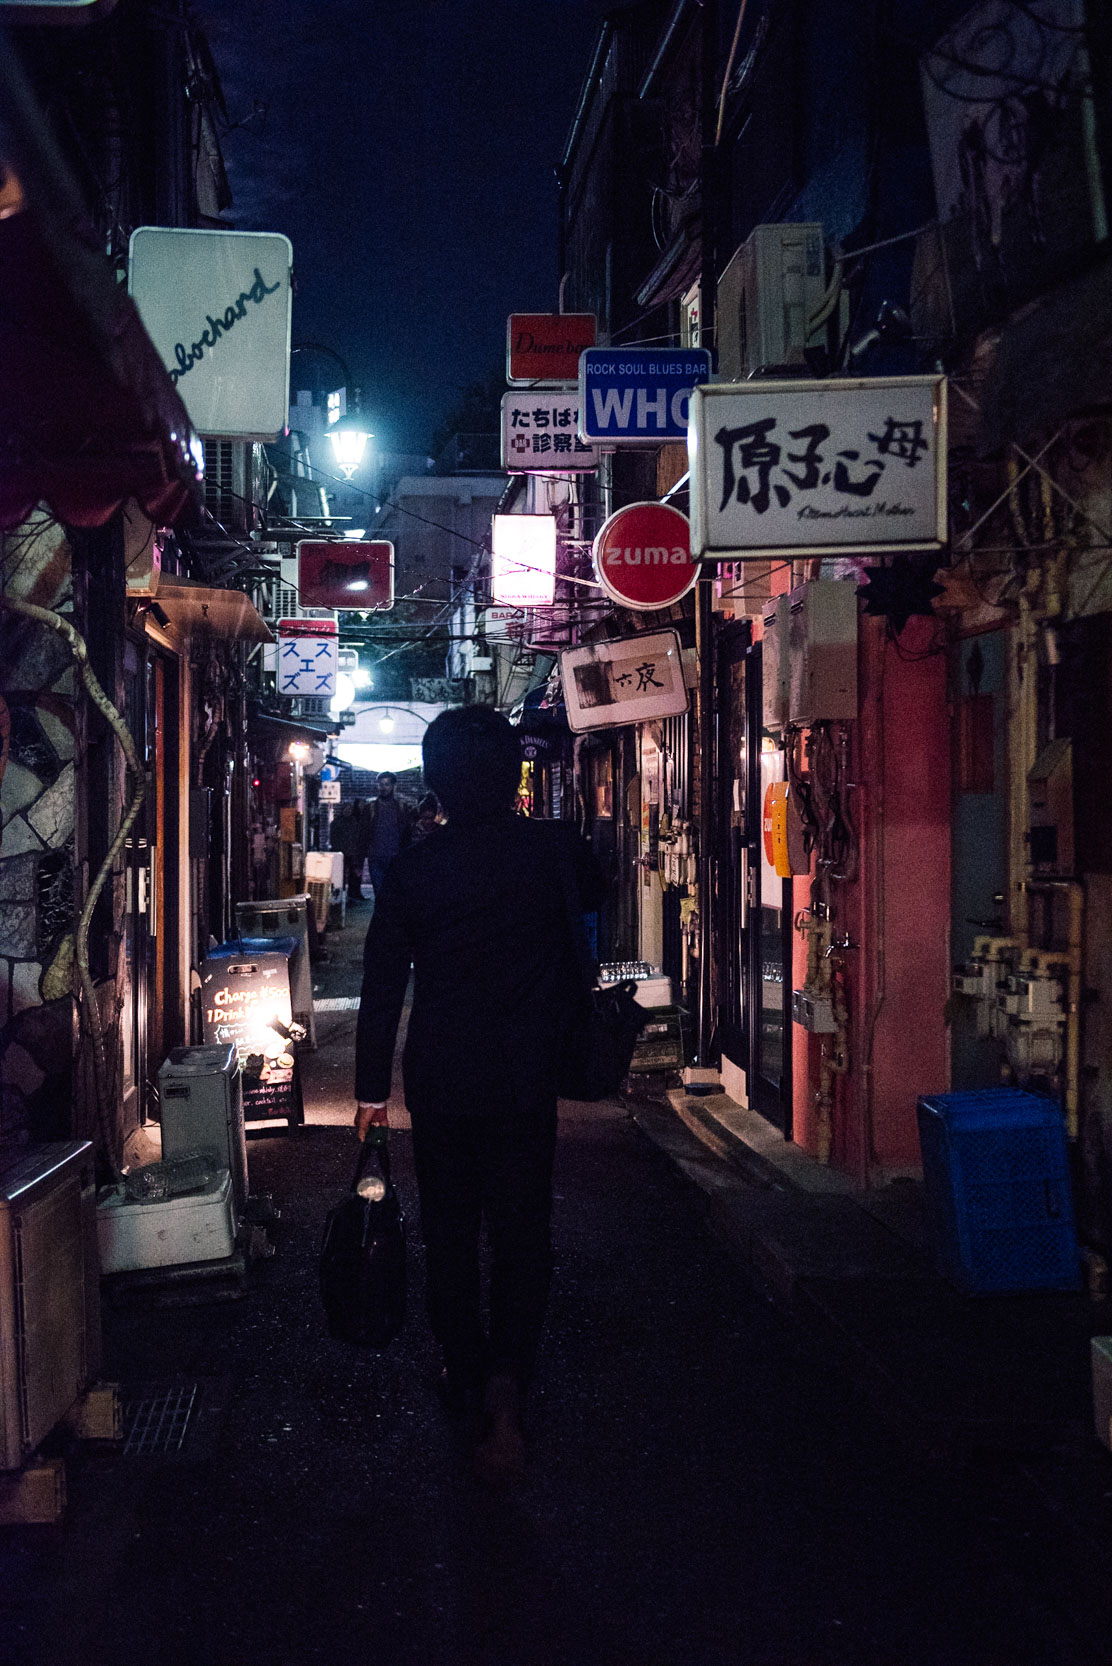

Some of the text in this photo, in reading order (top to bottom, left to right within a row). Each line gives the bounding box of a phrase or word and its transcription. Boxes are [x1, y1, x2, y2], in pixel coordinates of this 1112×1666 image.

[586, 363, 707, 375] ROCK SOUL BLUES BAR
[511, 408, 578, 428] たちば
[606, 546, 687, 565] zuma
[214, 986, 257, 1005] Charge
